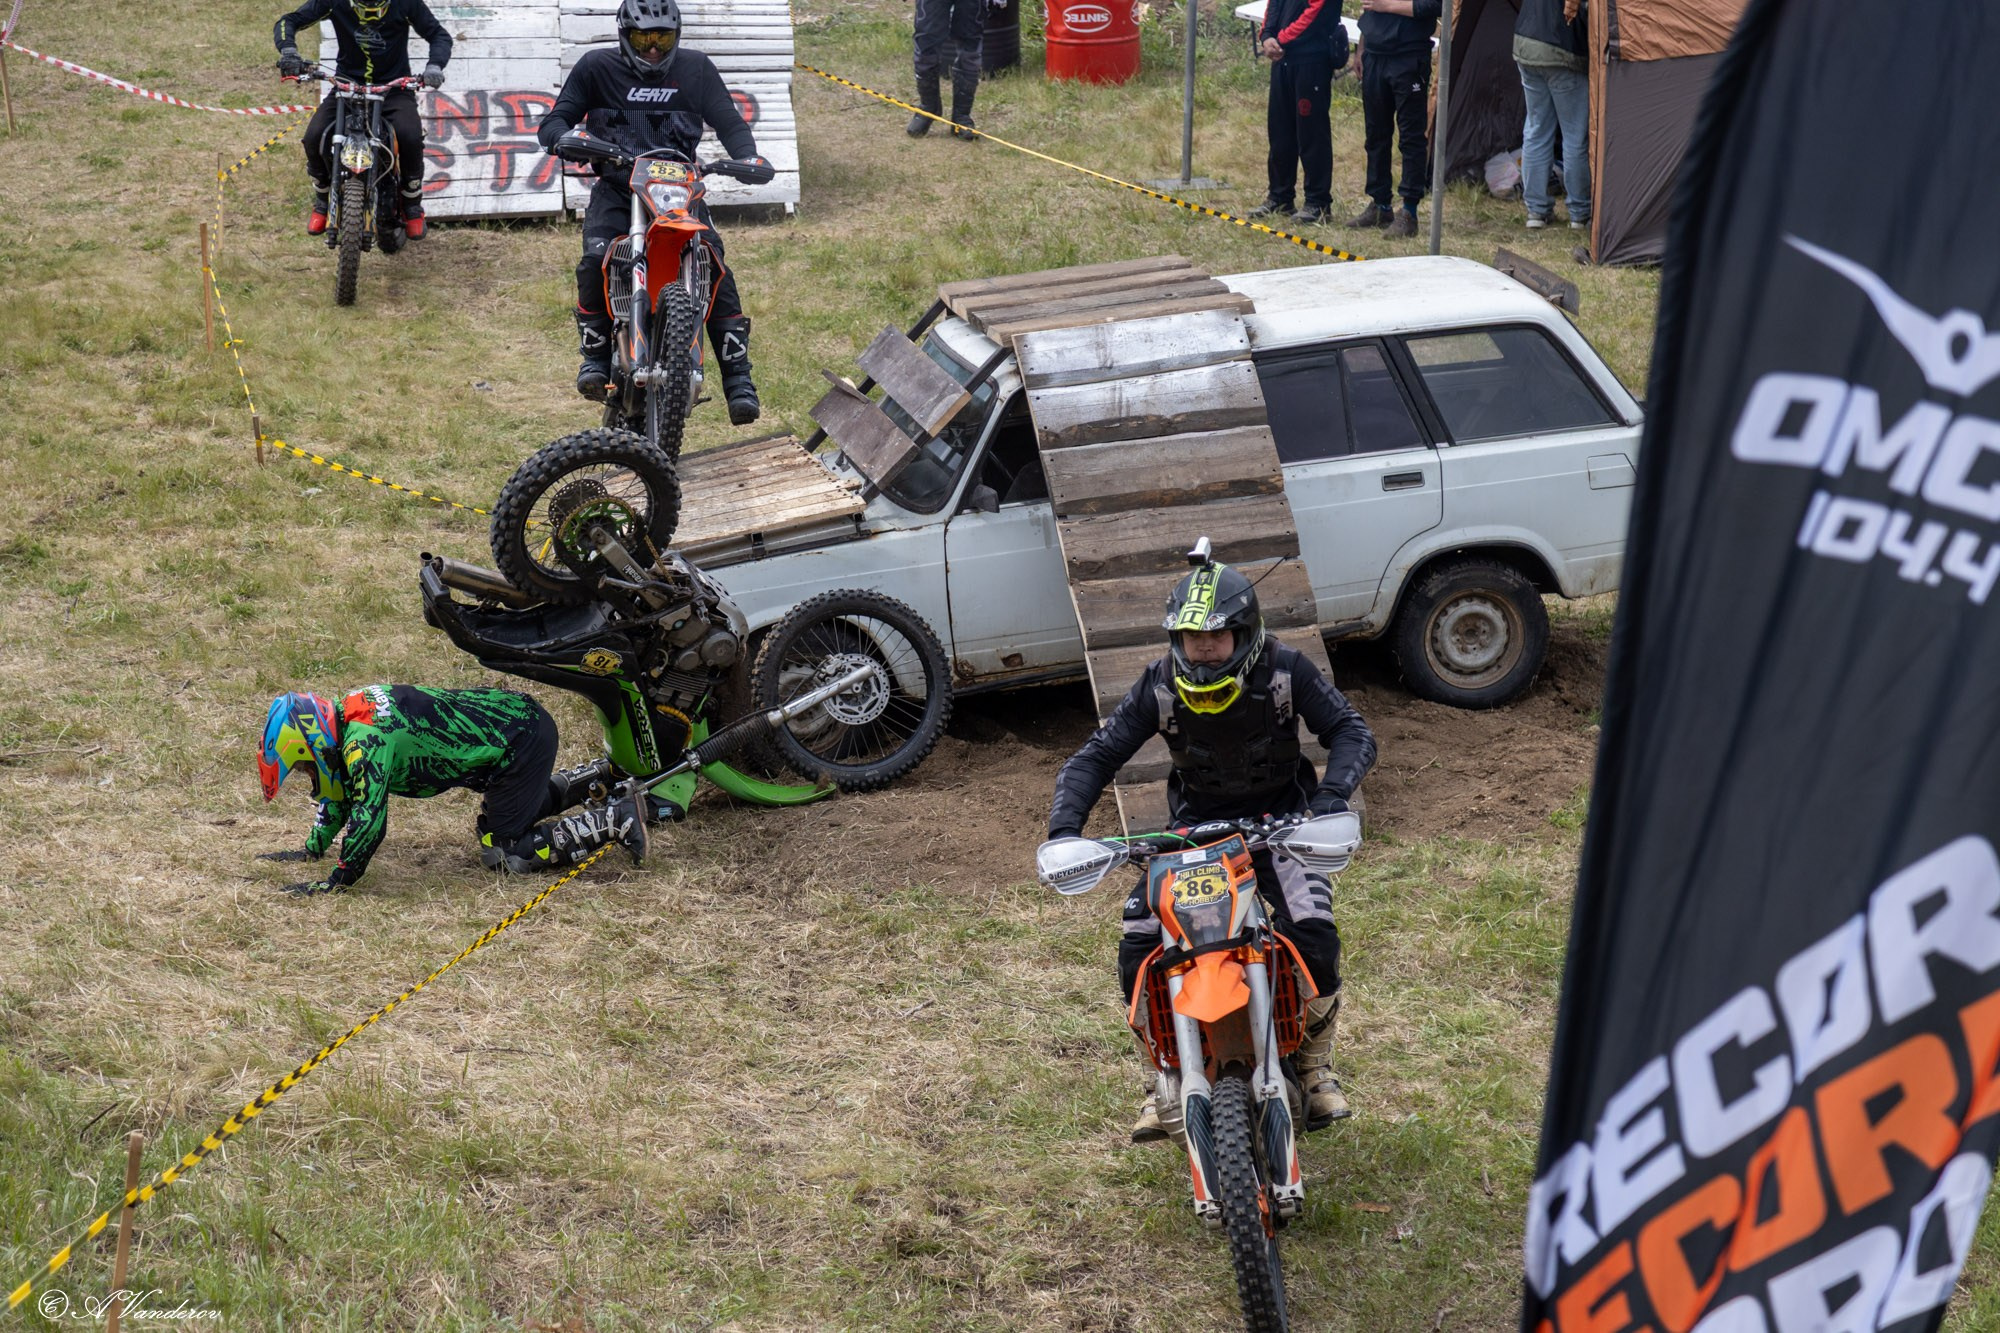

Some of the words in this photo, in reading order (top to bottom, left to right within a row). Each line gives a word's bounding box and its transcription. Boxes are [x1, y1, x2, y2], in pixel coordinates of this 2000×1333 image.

[1063, 12, 1110, 23] SINTEC
[626, 87, 679, 102] LEATT
[658, 166, 676, 179] 82
[633, 694, 662, 771] SHERPA
[1056, 865, 1085, 879] CYCRA
[1180, 869, 1197, 880] HILL
[1197, 866, 1221, 876] CLIMB
[1187, 879, 1214, 897] 86
[1188, 896, 1215, 905] HOBBY
